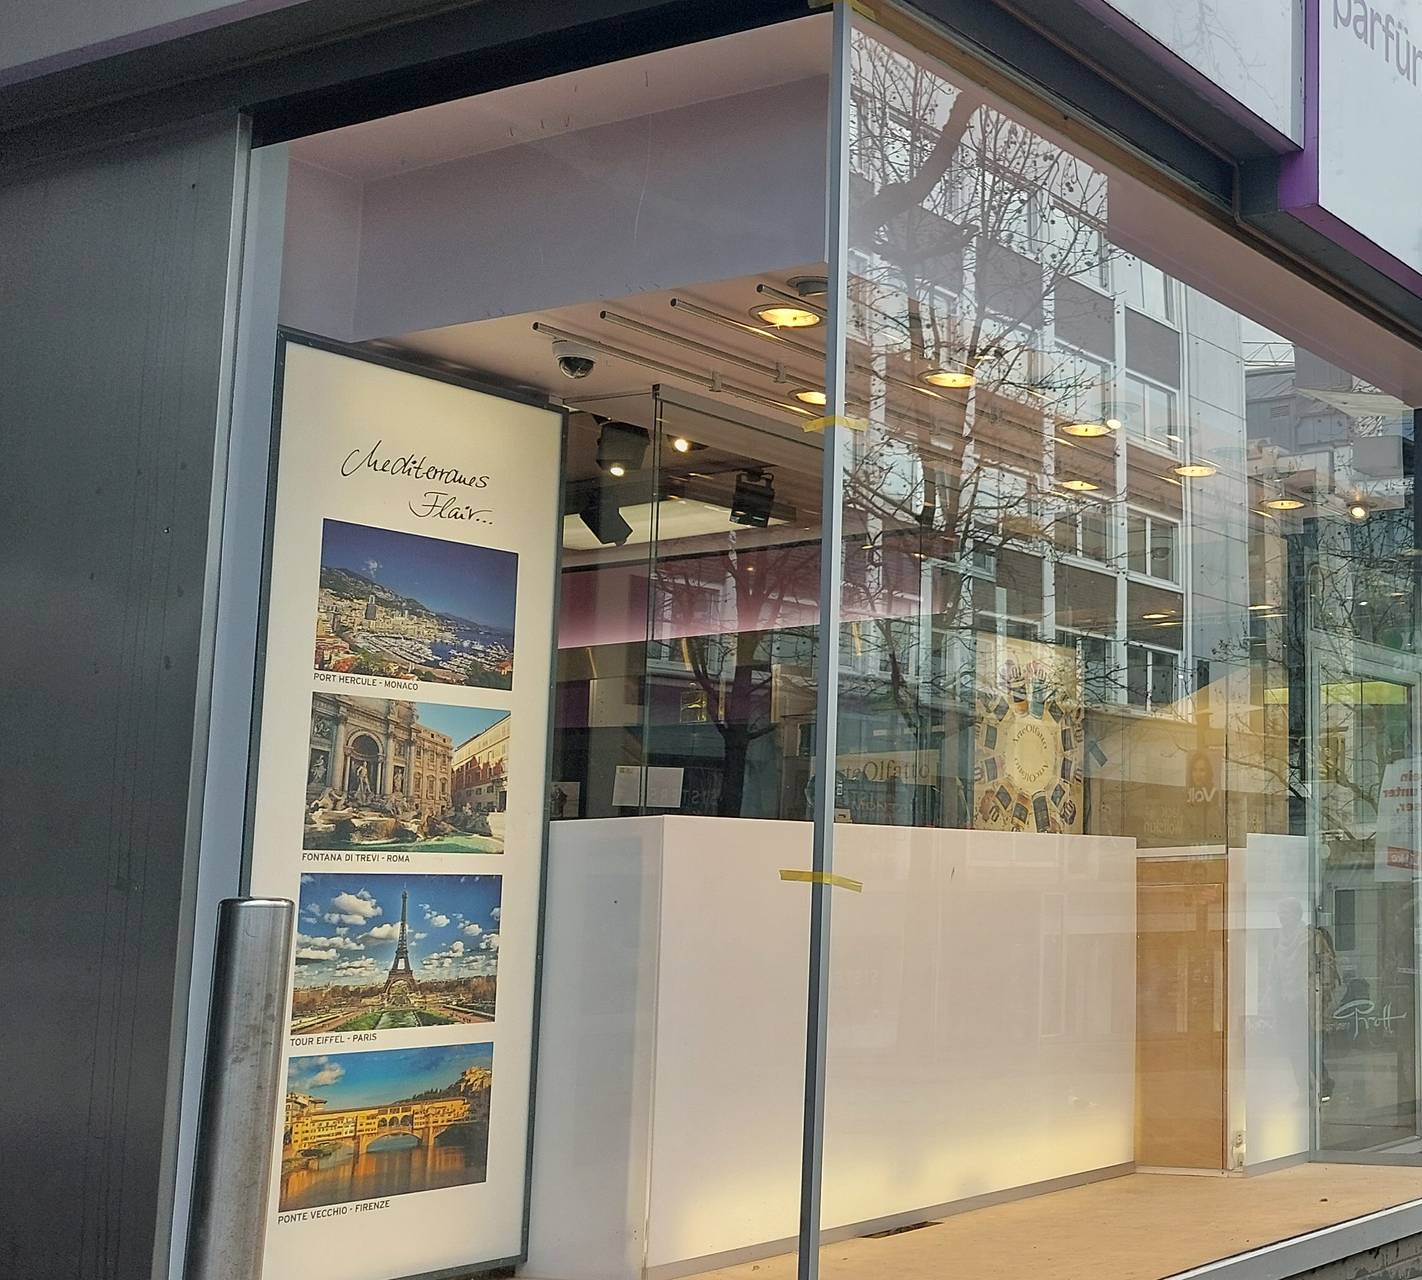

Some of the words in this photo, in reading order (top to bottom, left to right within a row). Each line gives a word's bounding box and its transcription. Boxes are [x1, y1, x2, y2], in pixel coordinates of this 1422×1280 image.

[341, 440, 490, 489] Mediterranes
[408, 491, 495, 525] Flair...
[313, 673, 337, 682] PORT
[339, 676, 377, 686] HERCULE
[384, 680, 419, 691] MONACO
[302, 853, 343, 862] FONTANA
[345, 853, 353, 862] DI
[356, 854, 380, 862] TREVI
[386, 854, 410, 862] ROMA
[290, 1037, 314, 1047] TOUR
[316, 1035, 345, 1045] EIFFEL
[352, 1033, 377, 1042] PARIS
[278, 1212, 308, 1225] PONTE
[310, 1206, 348, 1219] VECCHIO
[355, 1200, 390, 1213] FIRENZE
